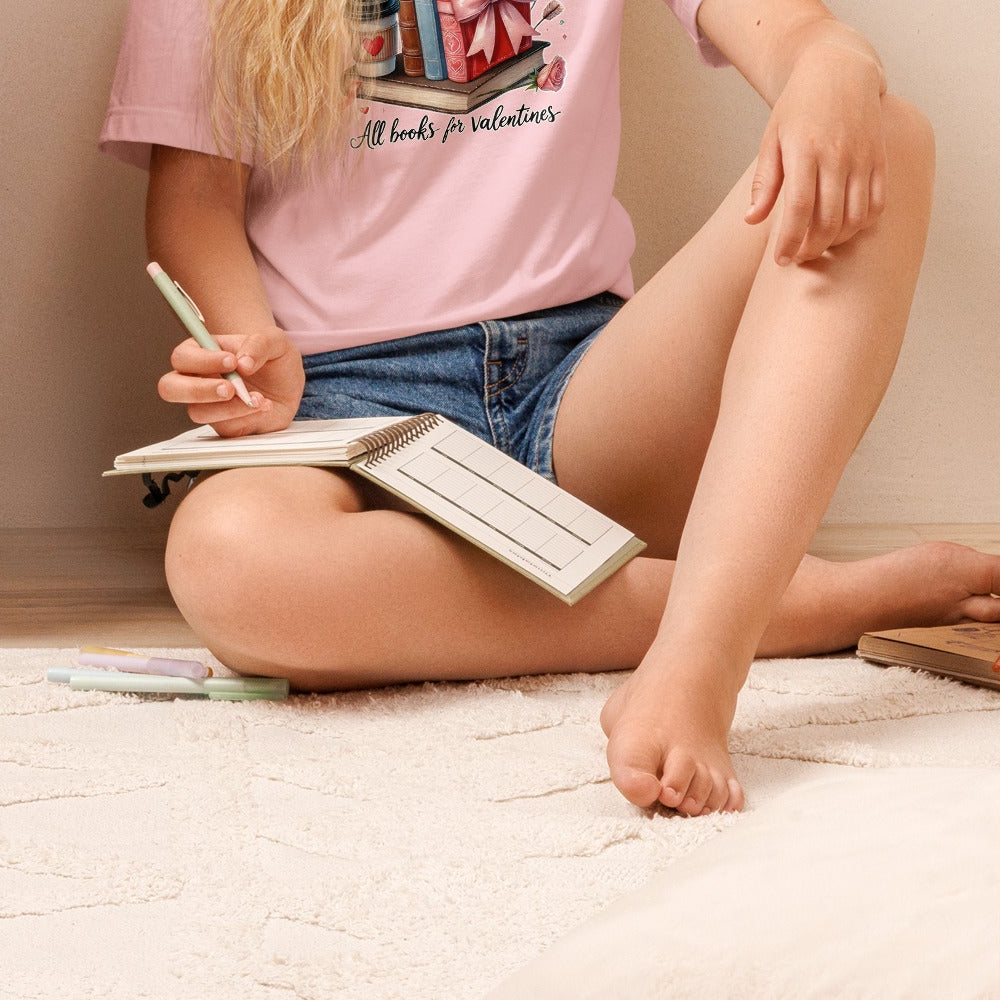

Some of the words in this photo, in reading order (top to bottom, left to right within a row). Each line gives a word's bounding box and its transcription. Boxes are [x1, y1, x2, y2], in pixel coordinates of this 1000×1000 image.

[350, 120, 387, 150] All
[390, 115, 440, 143] books
[441, 117, 466, 144] for
